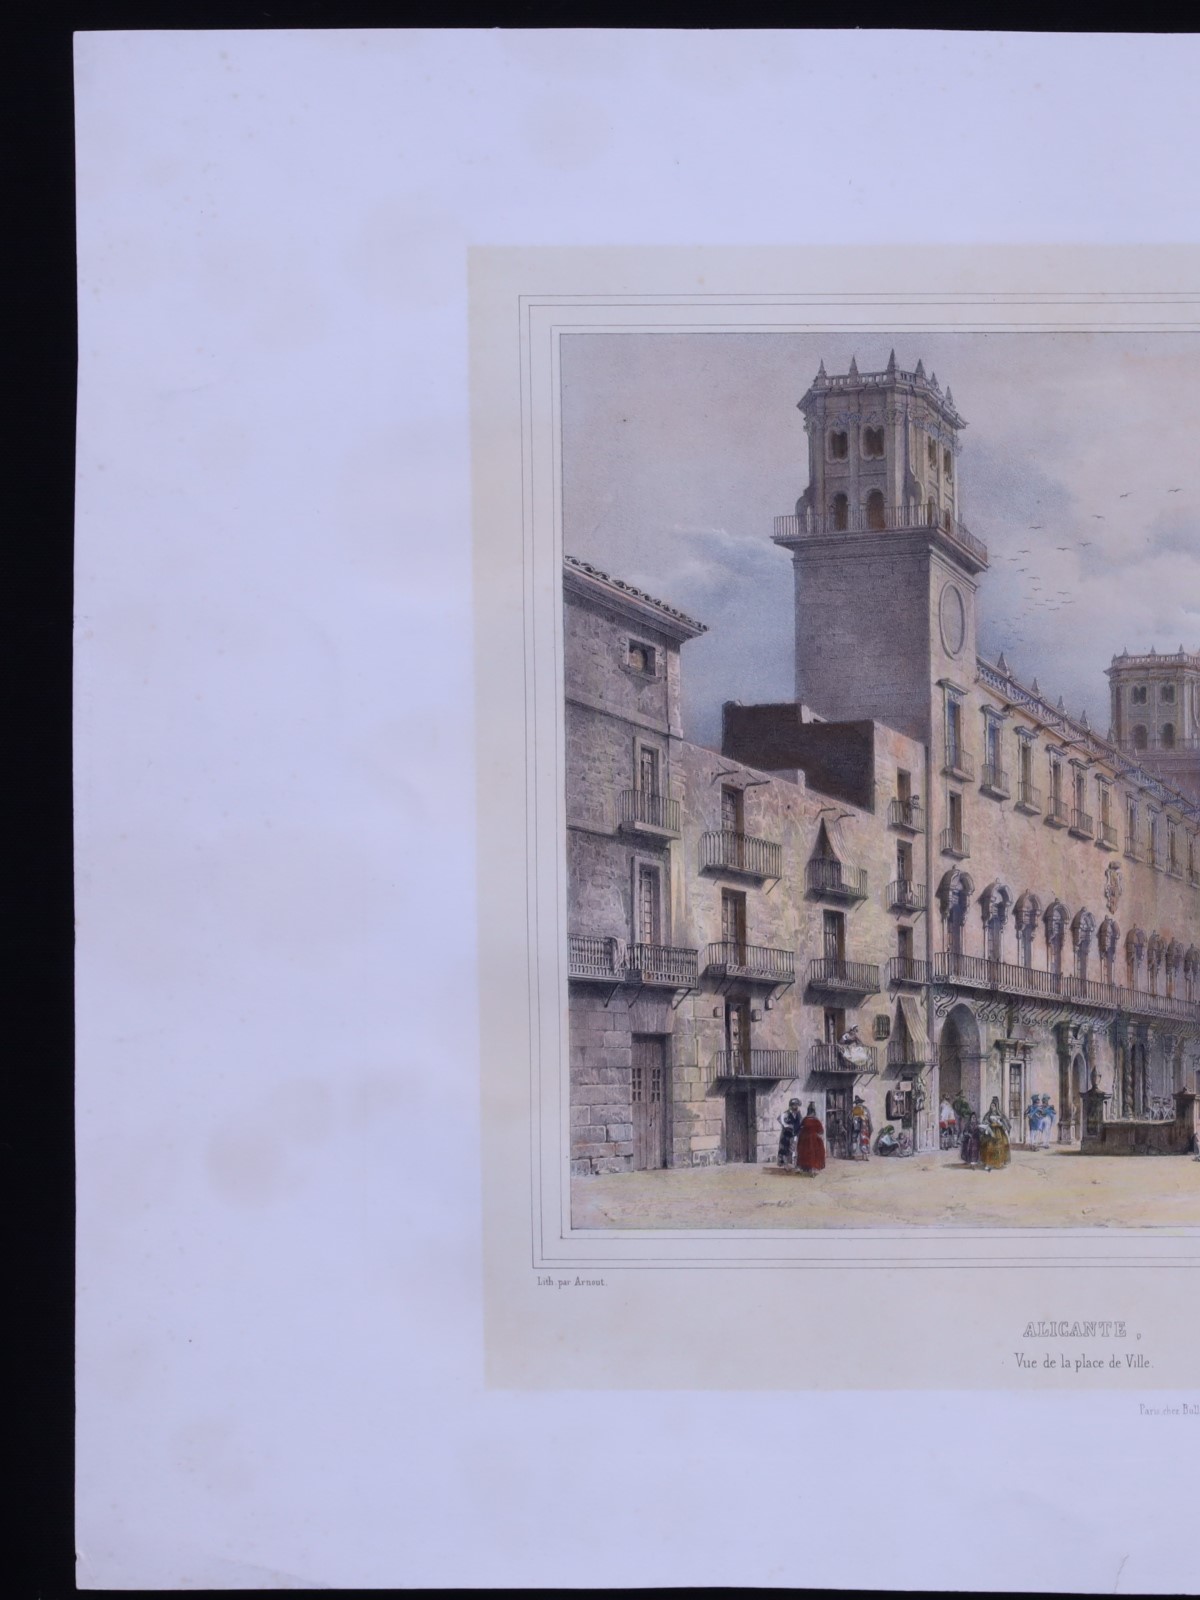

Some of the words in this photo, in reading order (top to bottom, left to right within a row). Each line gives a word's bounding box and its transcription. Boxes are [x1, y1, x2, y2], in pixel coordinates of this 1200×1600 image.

[558, 1279, 571, 1290] par
[1014, 1352, 1038, 1369] Vue
[1043, 1352, 1057, 1369] de
[1061, 1353, 1072, 1369] la
[1075, 1353, 1105, 1373] place
[1109, 1354, 1122, 1369] de
